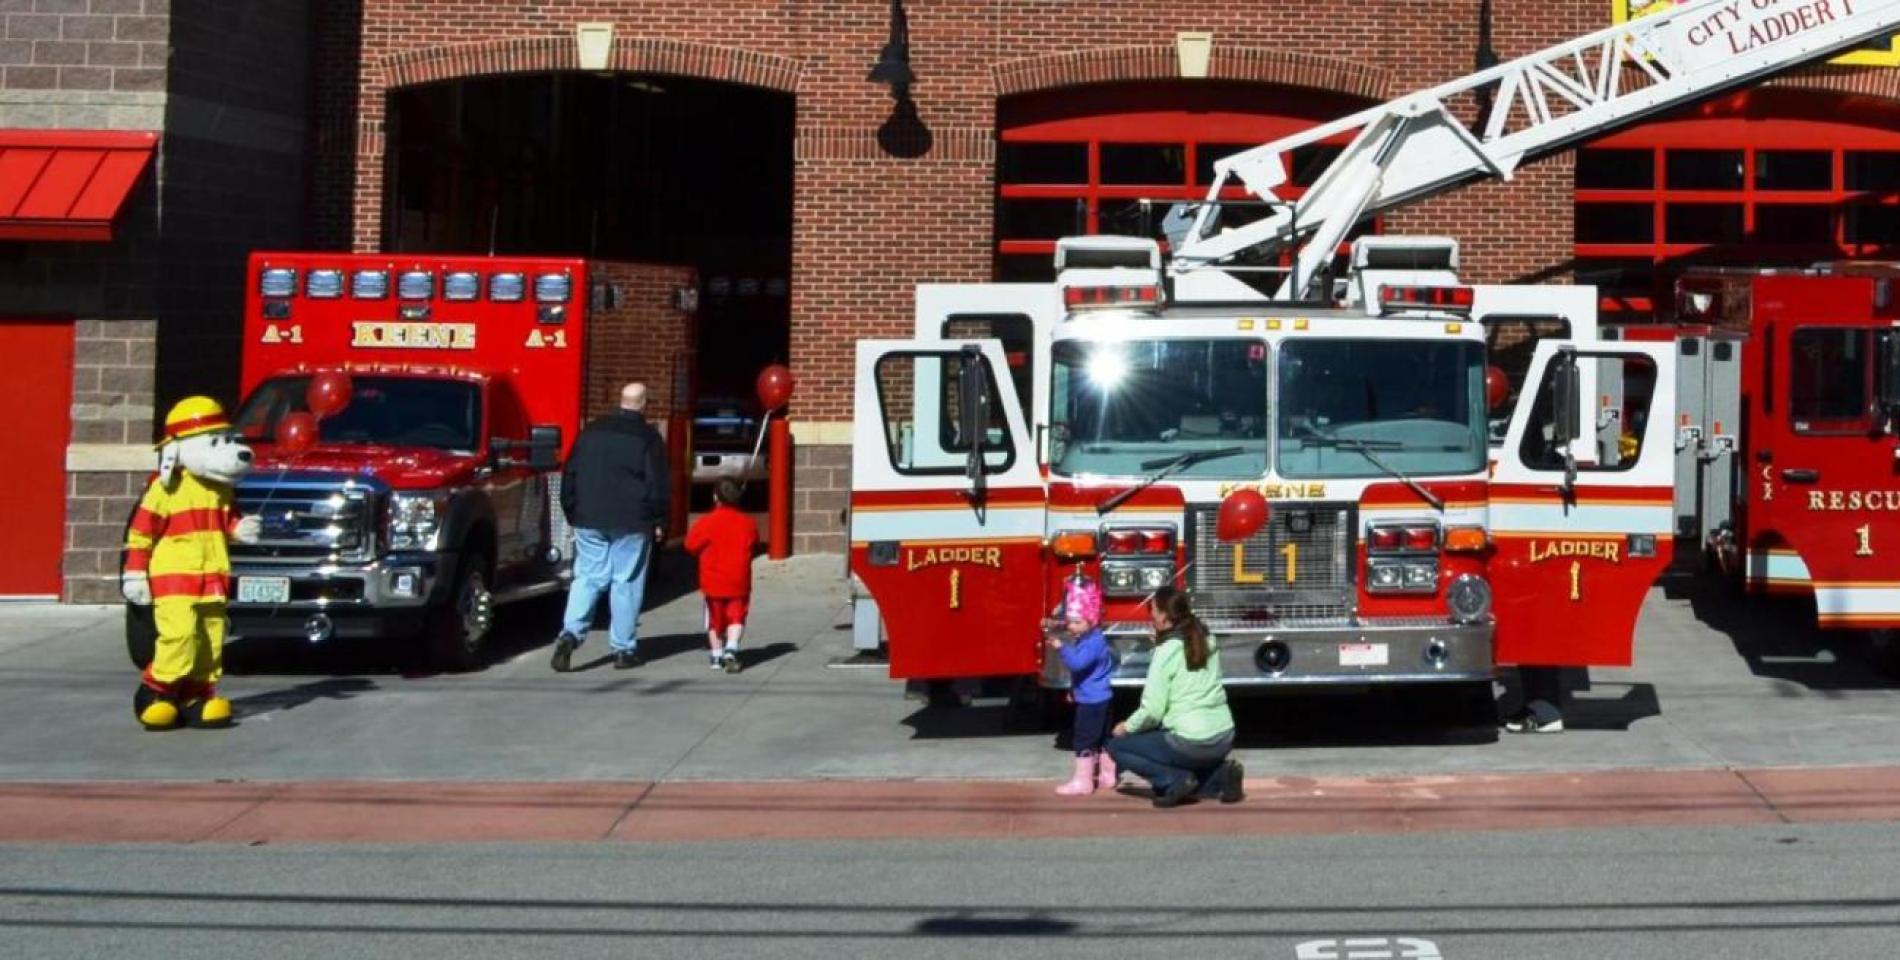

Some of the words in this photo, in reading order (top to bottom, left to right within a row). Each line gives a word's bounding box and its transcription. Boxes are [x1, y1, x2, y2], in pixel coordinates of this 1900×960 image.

[1687, 1, 1741, 46] CITY
[1727, 0, 1835, 54] LADDER
[261, 324, 304, 343] A-1
[352, 321, 476, 349] KEENE
[524, 328, 567, 348] A-1
[1217, 482, 1327, 498] KENE
[1529, 540, 1620, 563] LADDER
[1855, 522, 1874, 556] 1
[907, 547, 1001, 571] LADDER
[949, 568, 960, 609] 1
[1570, 560, 1581, 600] 1
